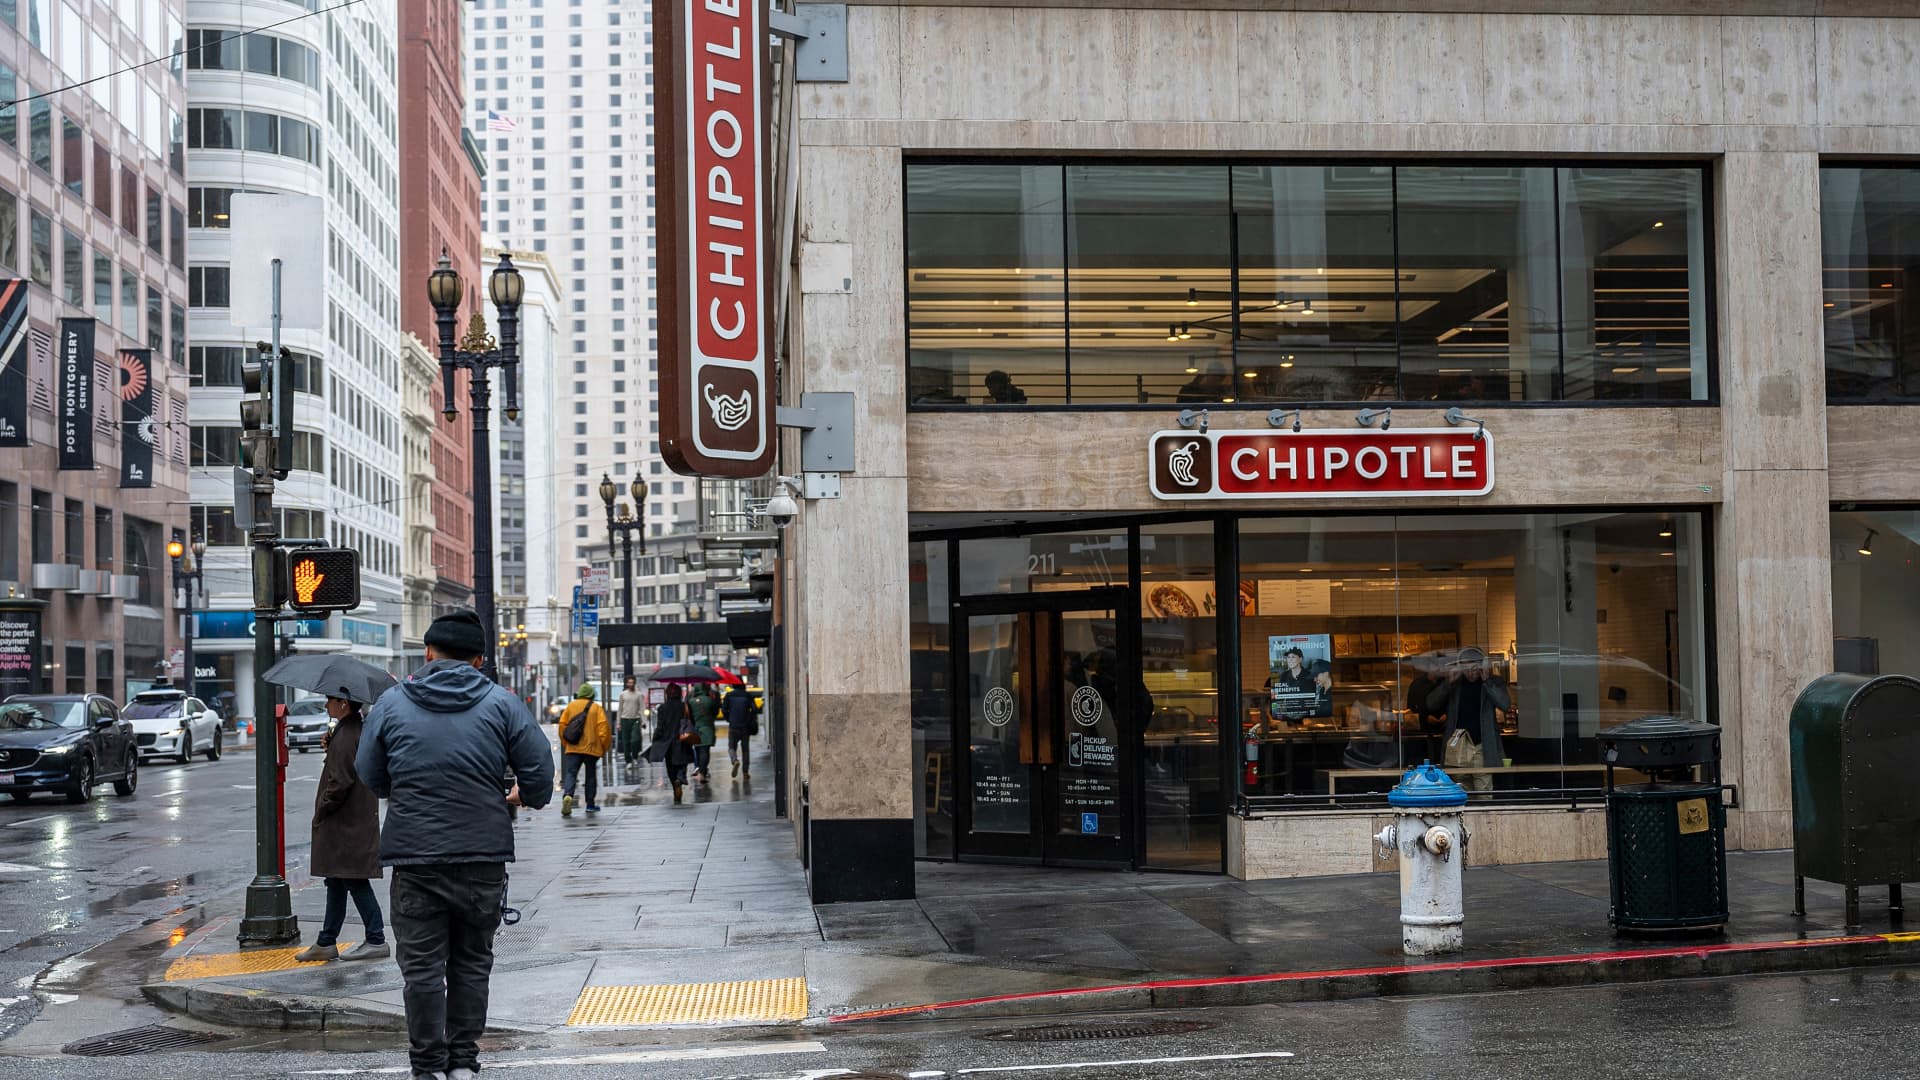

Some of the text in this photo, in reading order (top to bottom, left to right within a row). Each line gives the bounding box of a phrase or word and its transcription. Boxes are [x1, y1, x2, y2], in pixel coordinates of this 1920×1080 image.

[66, 331, 78, 453] POST MONTGOMERY
[1231, 446, 1477, 481] CHIPOTLE
[1028, 552, 1055, 575] 211
[0, 621, 29, 629] Discover
[12, 630, 35, 638] perfect
[0, 638, 30, 646] payment
[0, 662, 32, 670] Apple Pay
[194, 666, 216, 678] bank
[986, 689, 1011, 704] CHIPOTLE
[1074, 688, 1100, 704] CHIPOTLE
[1084, 736, 1107, 744] PICKUP
[1084, 744, 1114, 753] DELIVERY
[1084, 752, 1115, 761] REWARDS
